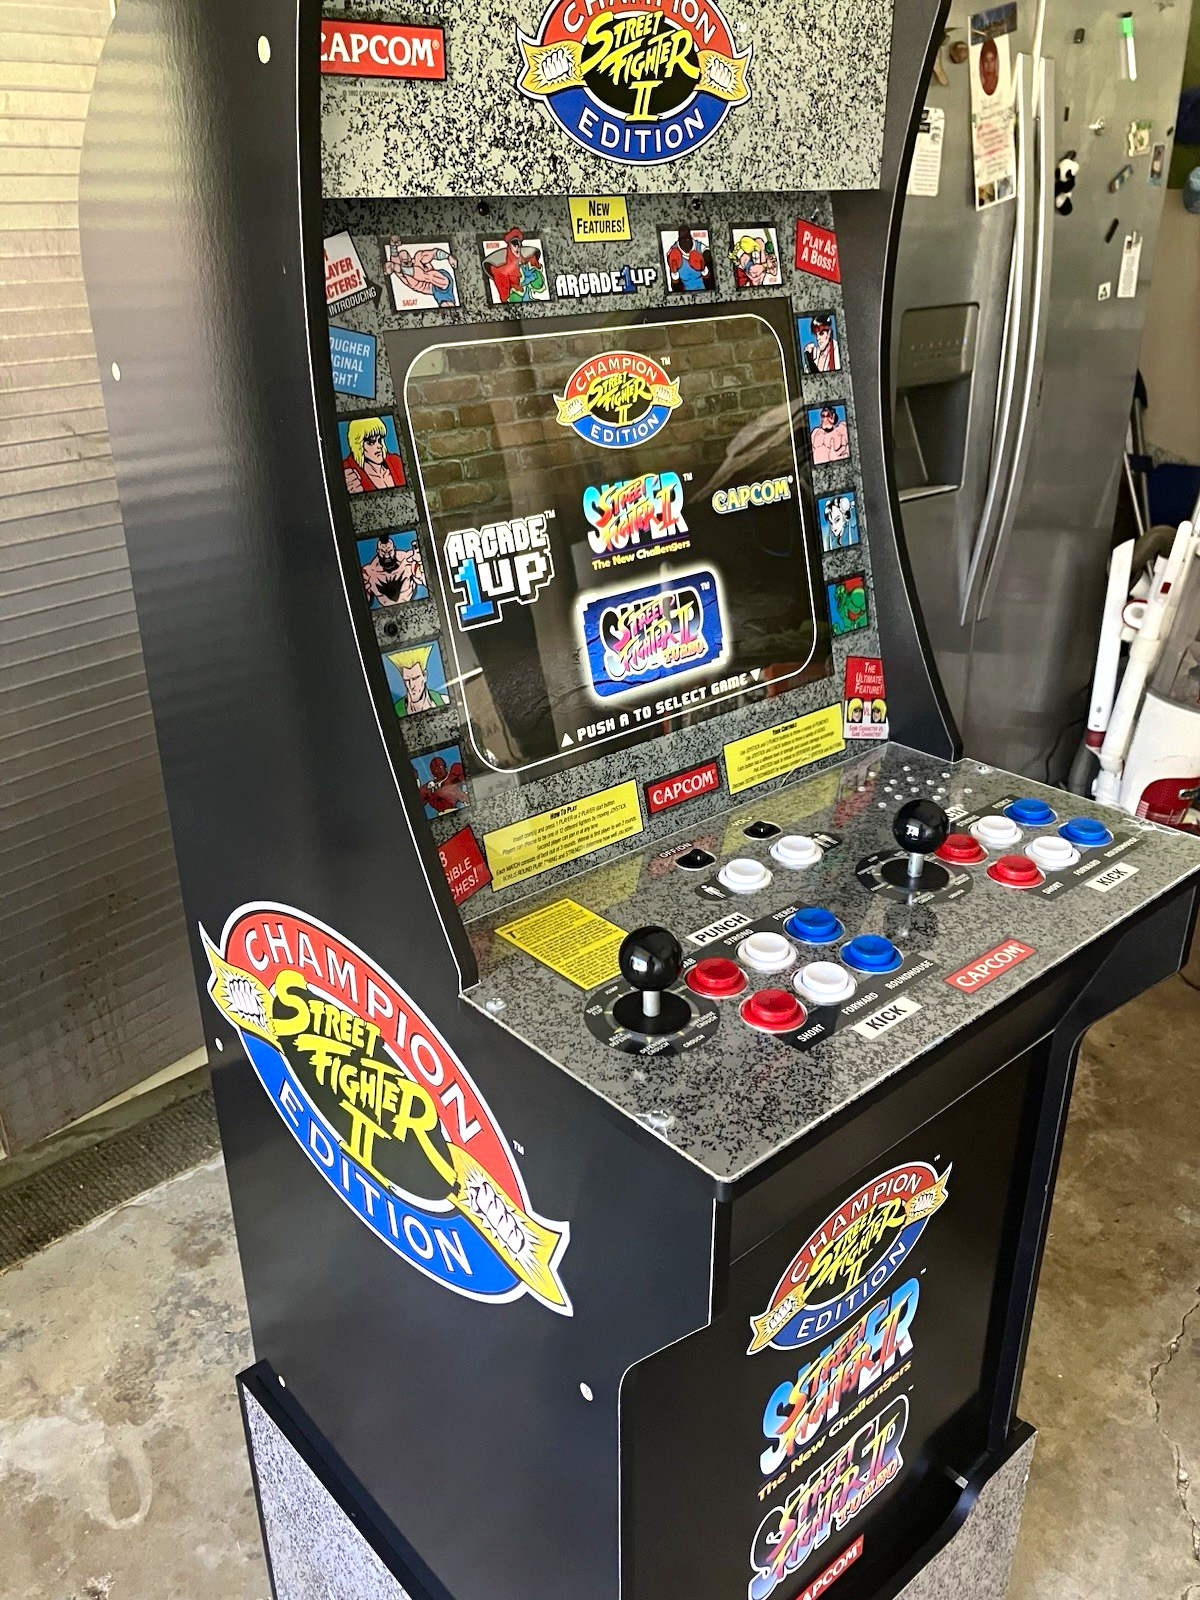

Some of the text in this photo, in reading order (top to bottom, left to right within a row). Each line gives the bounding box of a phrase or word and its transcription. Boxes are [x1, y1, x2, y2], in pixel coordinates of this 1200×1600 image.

[563, 0, 718, 45] CHION
[598, 28, 702, 84] FIGHTER
[624, 80, 664, 122] II
[577, 107, 705, 154] EDITION
[325, 257, 354, 280] AYER
[801, 247, 809, 261] A
[326, 268, 362, 299] CTERS!
[328, 287, 376, 316] INTRODUCING
[575, 357, 658, 392] CHAMPION
[596, 376, 653, 412] FIGHTER
[590, 413, 660, 444] EDITION
[615, 403, 634, 428] II
[711, 477, 792, 514] CAPCOM
[446, 516, 547, 568] ARCADE
[592, 540, 691, 571] The New Challengers
[454, 551, 548, 621] 1UP
[663, 641, 705, 665] TURBO
[576, 718, 616, 742] PUSH
[633, 706, 652, 724] TO
[655, 688, 707, 715] SELECT
[711, 672, 749, 697] GAME
[652, 770, 714, 805] CAPCOM
[659, 842, 693, 859] OFF/ON
[1096, 868, 1129, 887] KICK
[694, 915, 748, 943] PUNCH
[772, 905, 800, 922] FIERCE
[723, 929, 755, 946] STRONG
[884, 959, 934, 990] ROUNDHOUSE
[956, 943, 1026, 987] CAPCOM
[272, 969, 383, 1058] STREET
[842, 992, 879, 1016] FORWARD
[865, 1003, 908, 1031] KICK
[245, 921, 484, 1145] CHAMPION
[682, 1034, 705, 1048] CROUCH
[797, 1024, 826, 1044] SHORT
[293, 1033, 460, 1187] FIGHTER
[339, 1101, 393, 1191] II
[278, 1078, 475, 1277] EDITION
[790, 1172, 923, 1284] CHAMPION
[817, 1197, 907, 1288] FIGHTER
[802, 1203, 878, 1301] STREET
[797, 1241, 906, 1338] EDITION
[839, 1248, 873, 1299] II
[757, 1360, 912, 1501] The New Challengers
[838, 1458, 898, 1524] TURBO
